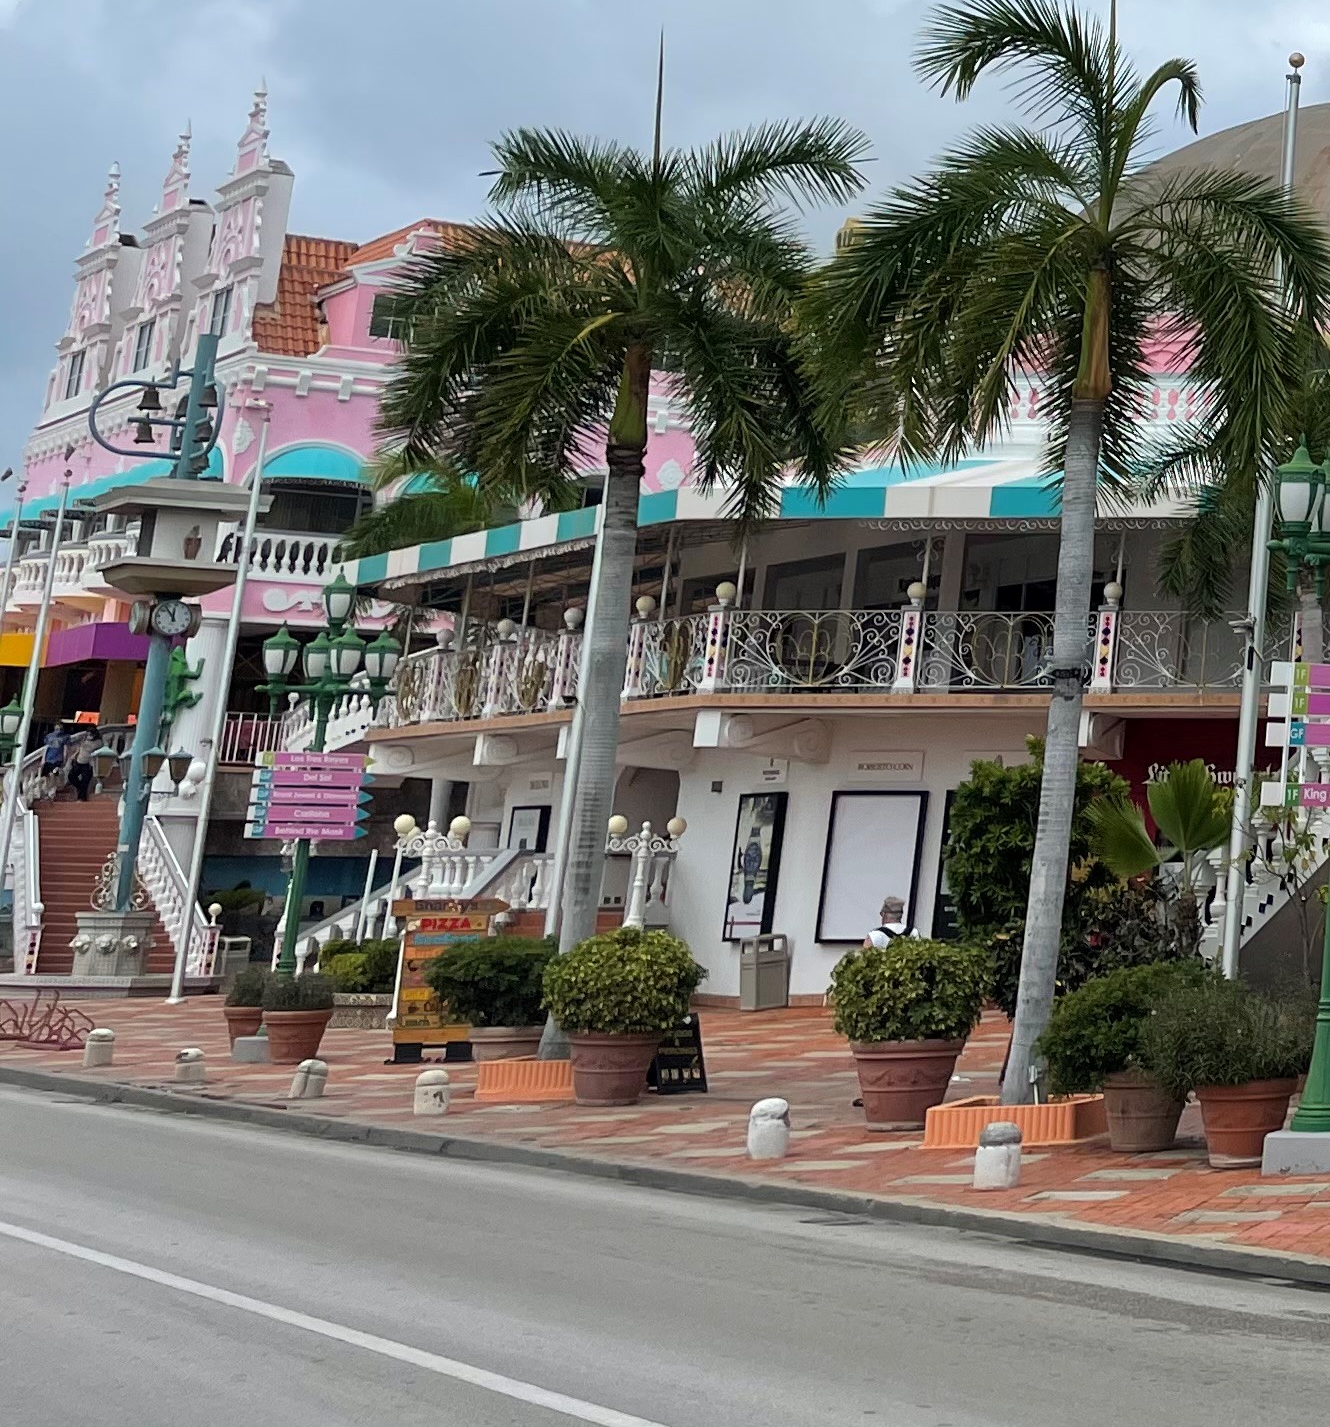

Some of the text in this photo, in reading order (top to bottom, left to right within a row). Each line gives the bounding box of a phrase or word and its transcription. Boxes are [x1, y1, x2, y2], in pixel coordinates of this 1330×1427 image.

[1290, 728, 1304, 740] GF
[1287, 788, 1299, 801] 1F
[1303, 789, 1327, 803] King
[420, 917, 471, 930] PIZZA
